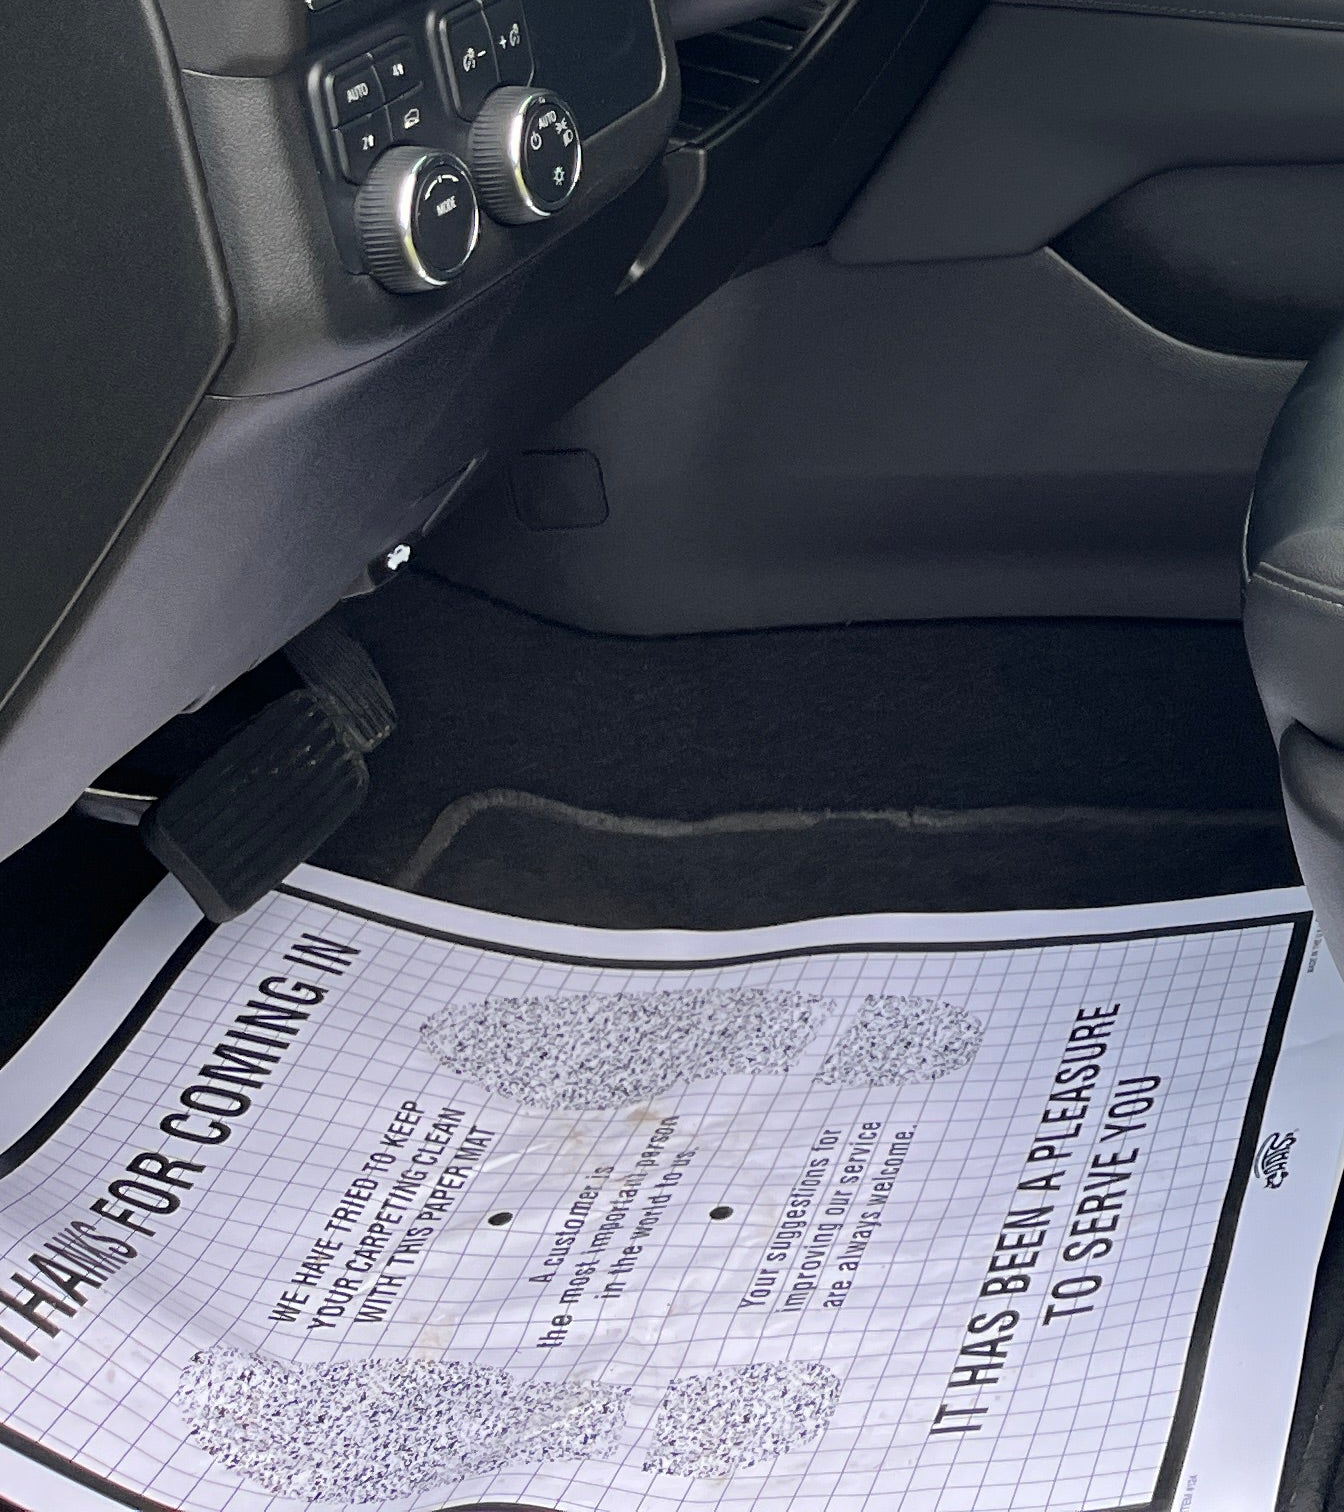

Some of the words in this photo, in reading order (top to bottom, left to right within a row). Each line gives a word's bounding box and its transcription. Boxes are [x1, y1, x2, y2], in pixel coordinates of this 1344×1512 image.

[347, 83, 368, 103] AUTO
[539, 110, 556, 130] AUTO
[436, 195, 457, 216] MODE
[89, 1152, 206, 1237] FOR
[160, 976, 329, 1145] COMING
[283, 933, 361, 977] IN
[1027, 1002, 1121, 1164] PLEASURE
[1100, 1075, 1162, 1143] YOU
[654, 1171, 683, 1188] to
[867, 1124, 918, 1207] welcome.
[1016, 1170, 1065, 1191] A
[268, 1291, 310, 1323] WE
[291, 1238, 343, 1286] HAVE
[324, 1178, 378, 1232] TRIED
[362, 1152, 396, 1172] TO
[380, 1101, 425, 1148] KEEP
[307, 1277, 363, 1329] YOUR
[345, 1169, 428, 1272] CARPETING
[412, 1107, 466, 1166] CLEAN
[354, 1274, 406, 1322] WITH
[386, 1227, 434, 1266] THIS
[416, 1166, 473, 1221] PAPER
[454, 1125, 495, 1161] MAT
[529, 1272, 556, 1284] A
[544, 1185, 603, 1266] customer
[586, 1166, 614, 1179] is
[537, 1314, 573, 1348] the
[559, 1258, 600, 1304] most
[581, 1172, 647, 1255] important
[637, 1115, 680, 1168] person
[630, 1193, 672, 1240] world
[737, 1268, 779, 1309] Your
[767, 1157, 830, 1262] suggestions
[811, 1129, 842, 1151] for
[774, 1223, 844, 1313] improving
[825, 1190, 853, 1216] our
[840, 1122, 881, 1184] service
[1063, 1147, 1139, 1260] SERVE
[608, 1245, 643, 1275] the
[837, 1211, 882, 1271] always
[979, 1205, 1055, 1299] BEEN
[594, 1280, 626, 1299] in
[823, 1280, 852, 1308] are
[1042, 1274, 1103, 1326] TO
[947, 1309, 1020, 1389] HAS
[929, 1403, 989, 1436] IT
